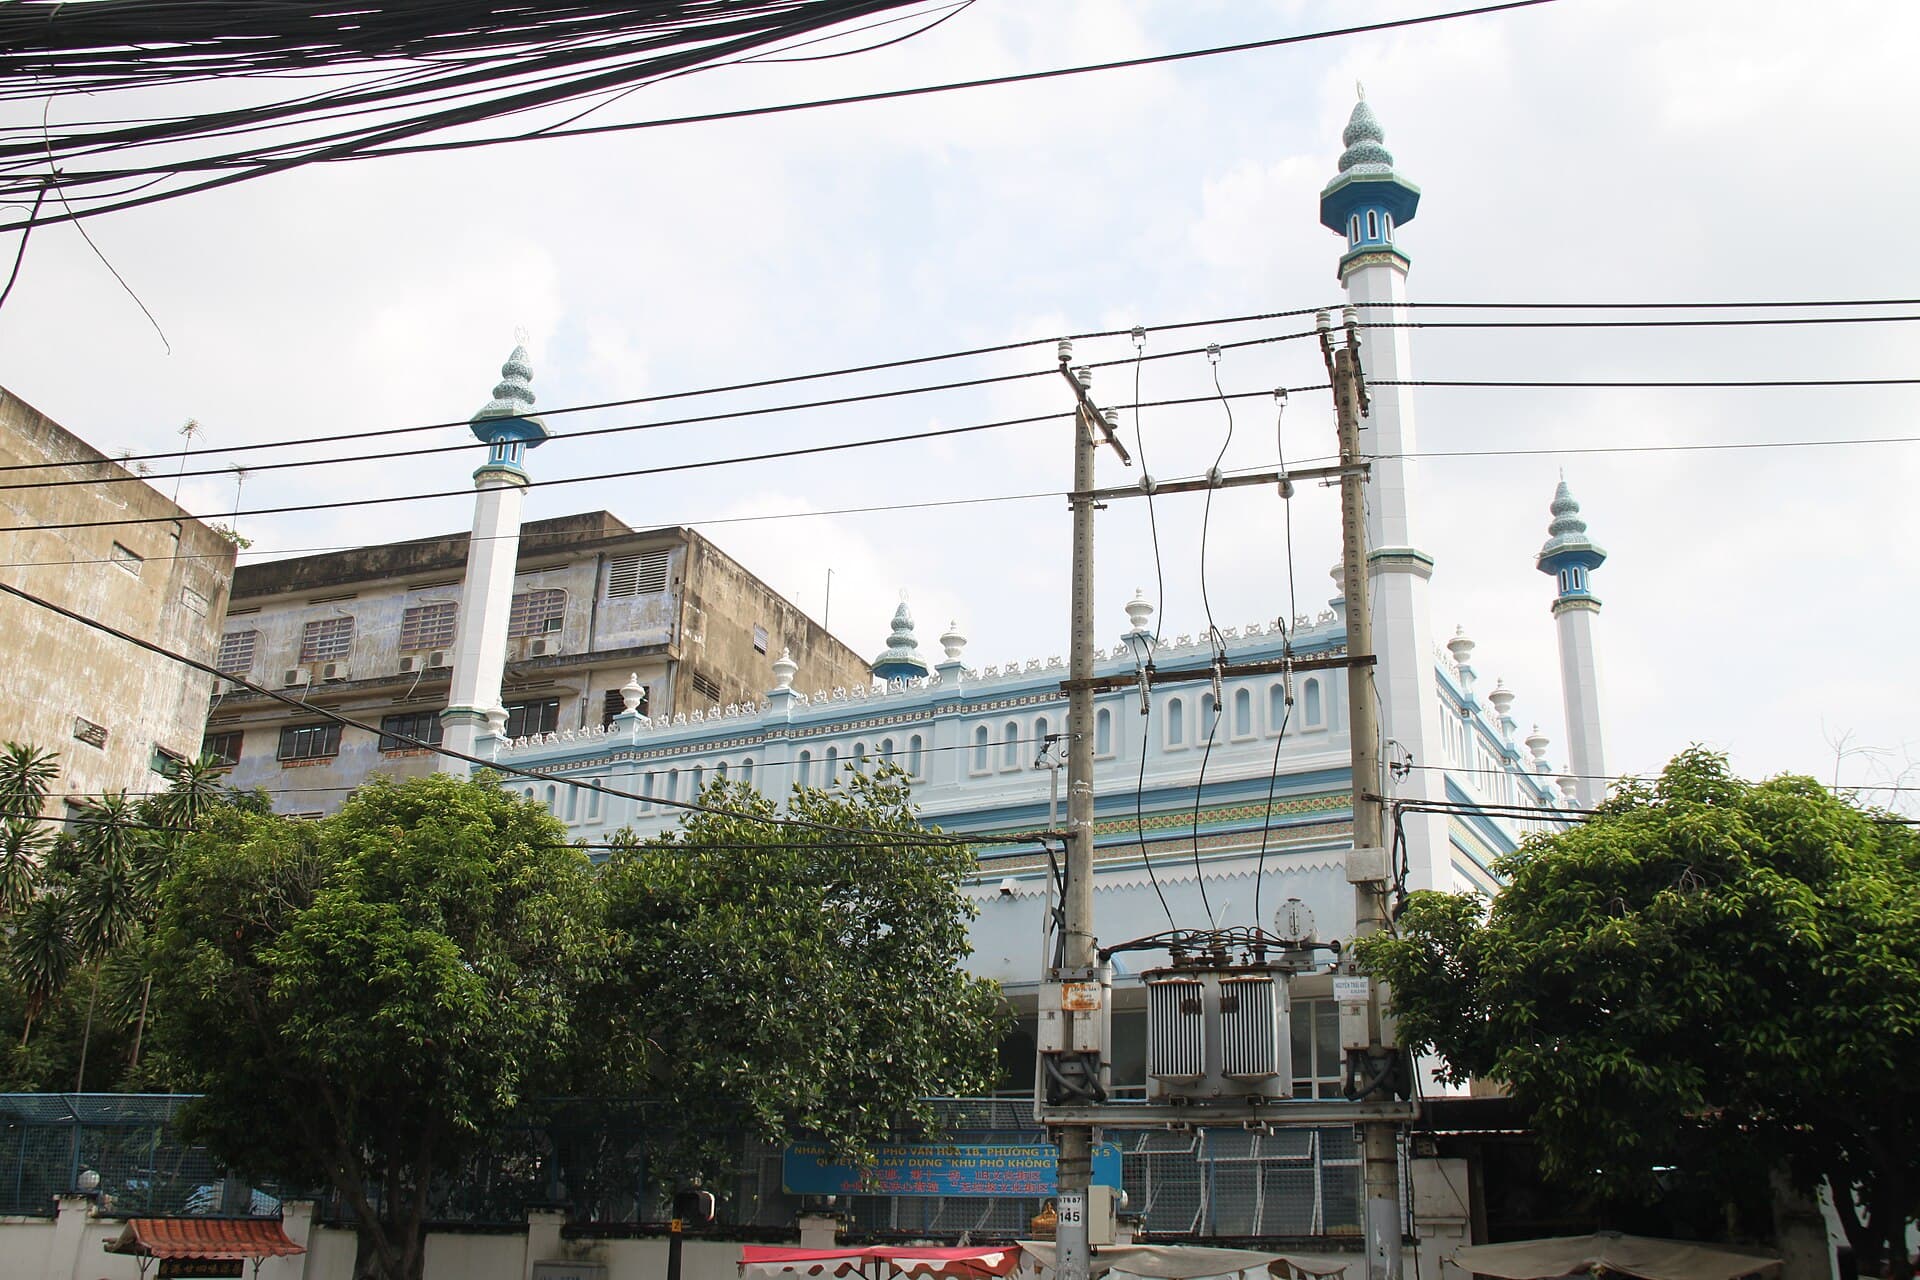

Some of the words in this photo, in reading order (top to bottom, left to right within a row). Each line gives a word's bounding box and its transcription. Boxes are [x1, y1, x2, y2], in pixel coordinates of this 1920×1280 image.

[1103, 1148, 1111, 1157] 5
[1008, 1158, 1051, 1168] KHÔNG
[1060, 1210, 1080, 1222] 145
